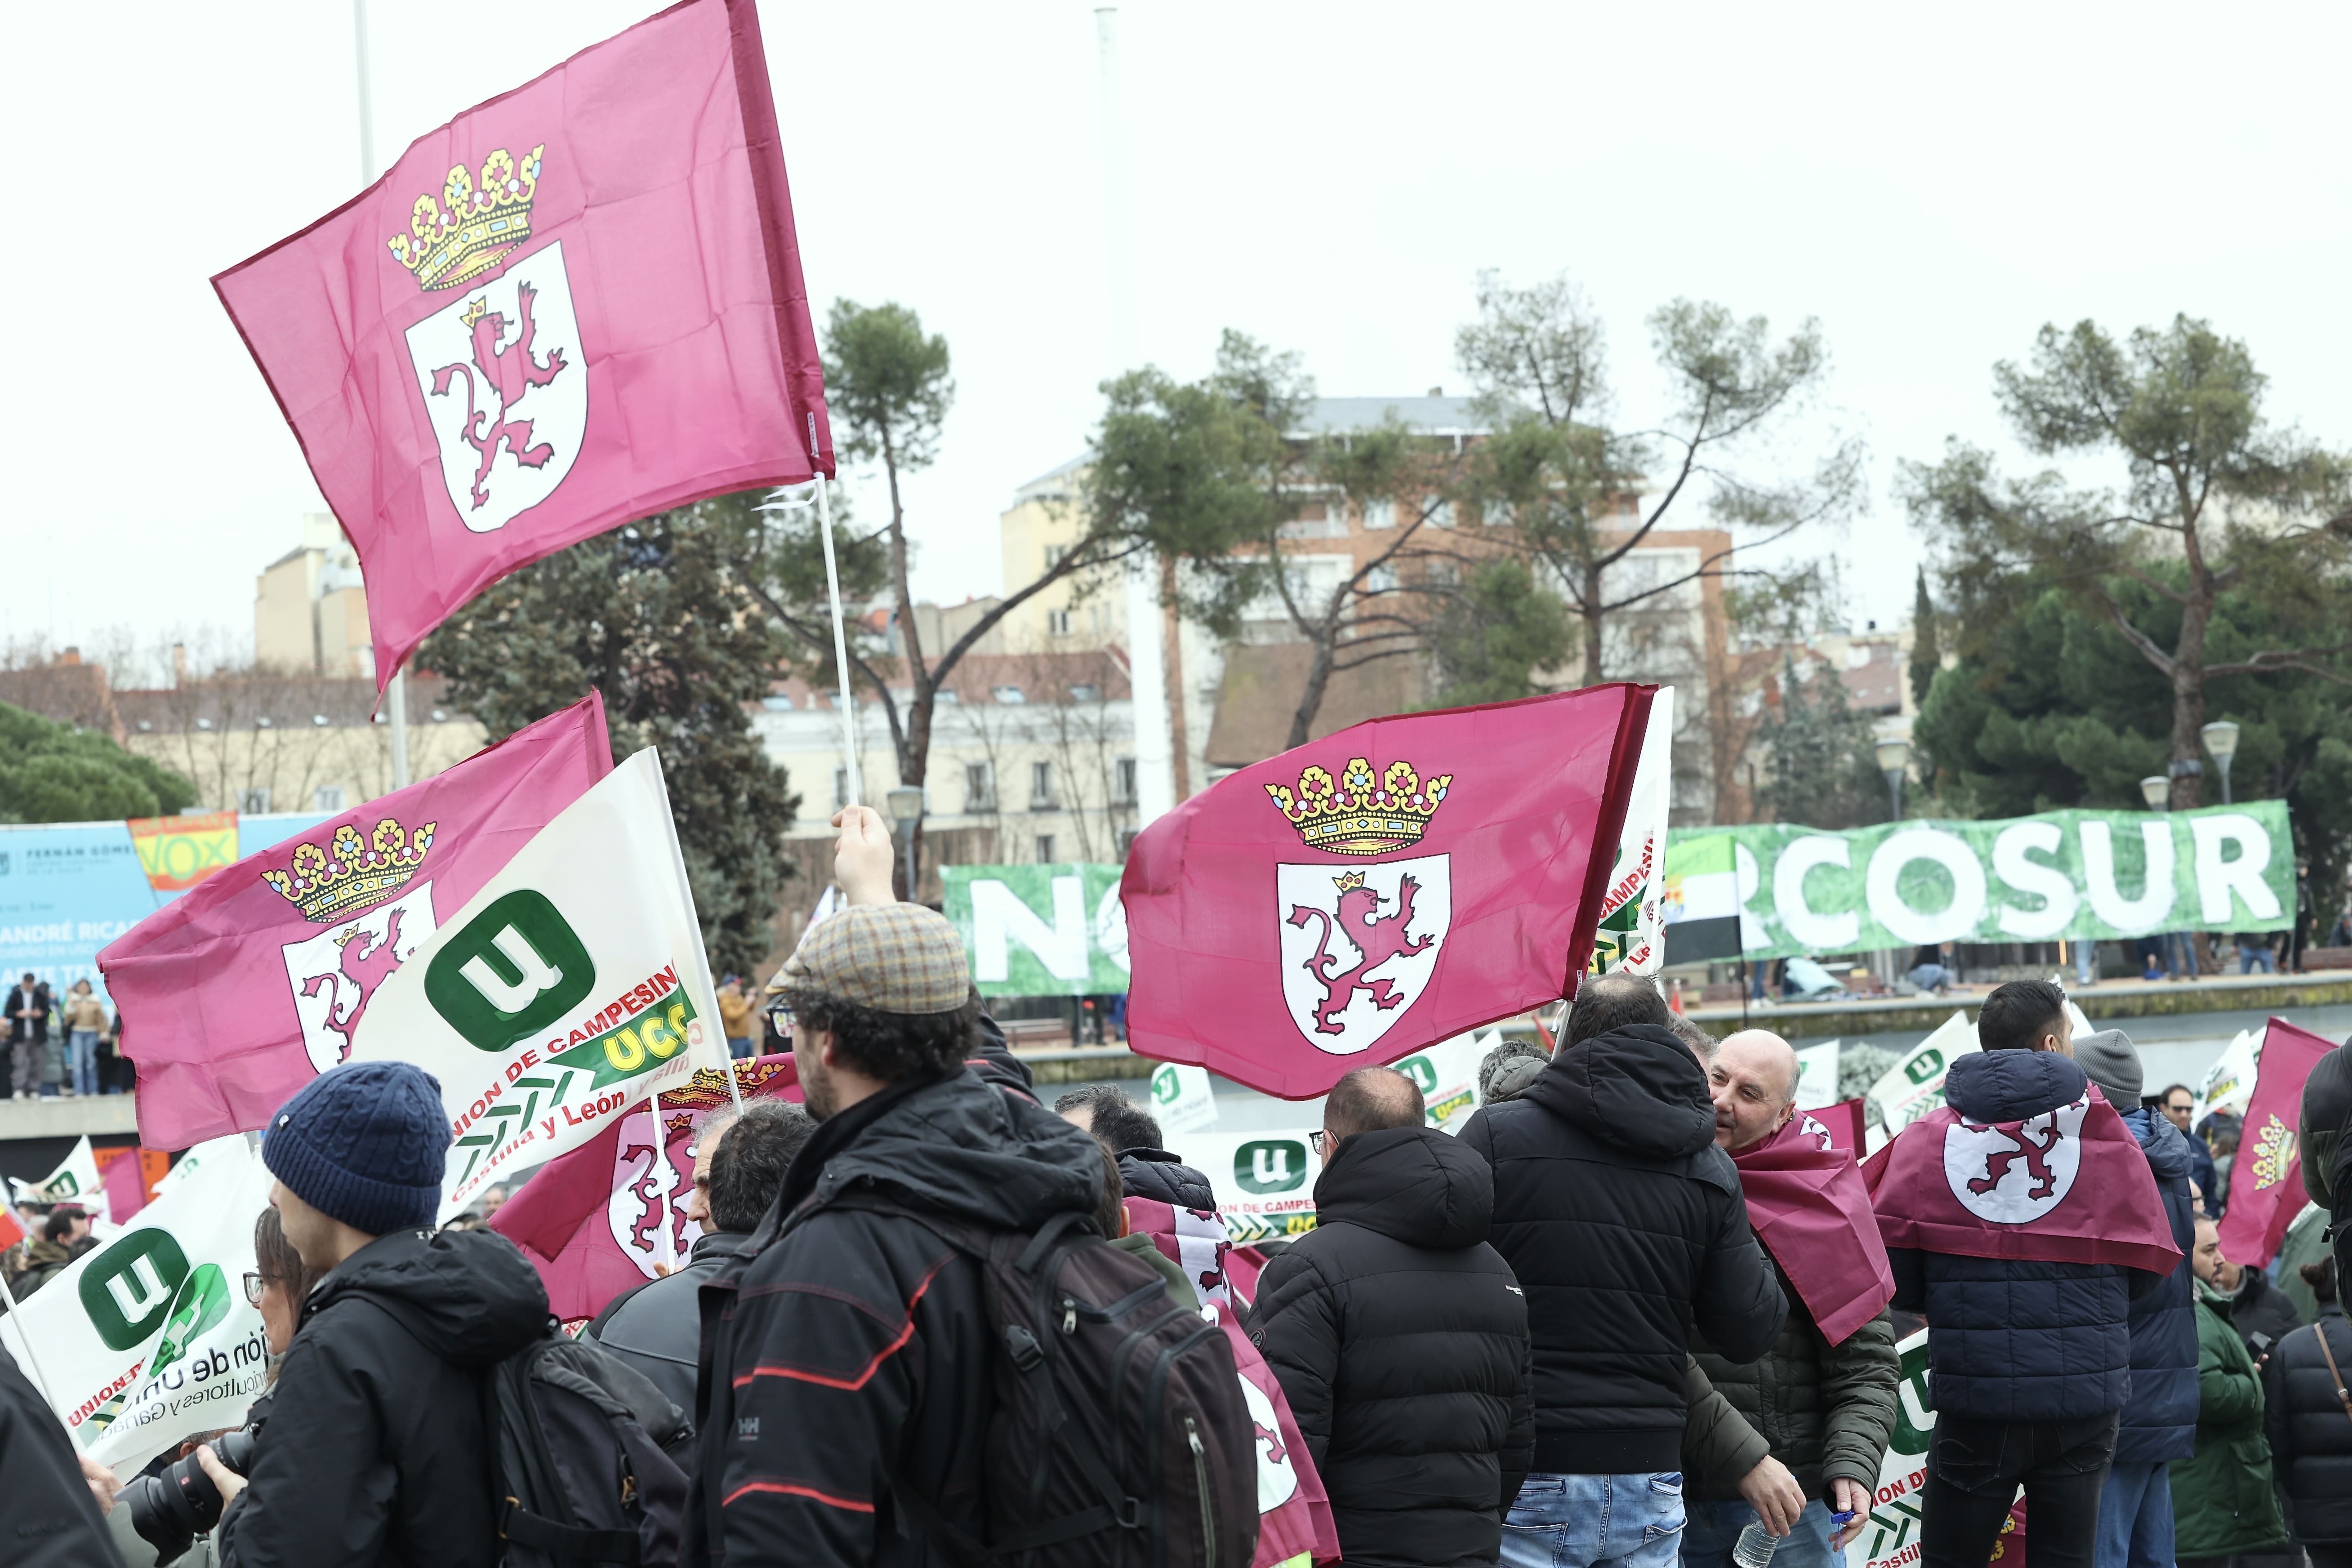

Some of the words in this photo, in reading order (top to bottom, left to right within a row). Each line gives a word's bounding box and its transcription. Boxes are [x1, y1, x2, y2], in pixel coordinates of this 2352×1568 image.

[140, 833, 230, 881] VOX
[450, 1081, 502, 1145] NION
[505, 1049, 541, 1083] DE
[547, 958, 678, 1053] CAMPESIN
[602, 1003, 689, 1072] UCC
[452, 1130, 535, 1203] Castilla
[540, 1117, 555, 1140] y
[561, 1091, 625, 1126] León
[1243, 1203, 1261, 1213] DE
[1265, 1199, 1316, 1212] CAMPE
[67, 1376, 126, 1427] UNION
[1873, 1479, 1906, 1507] ION
